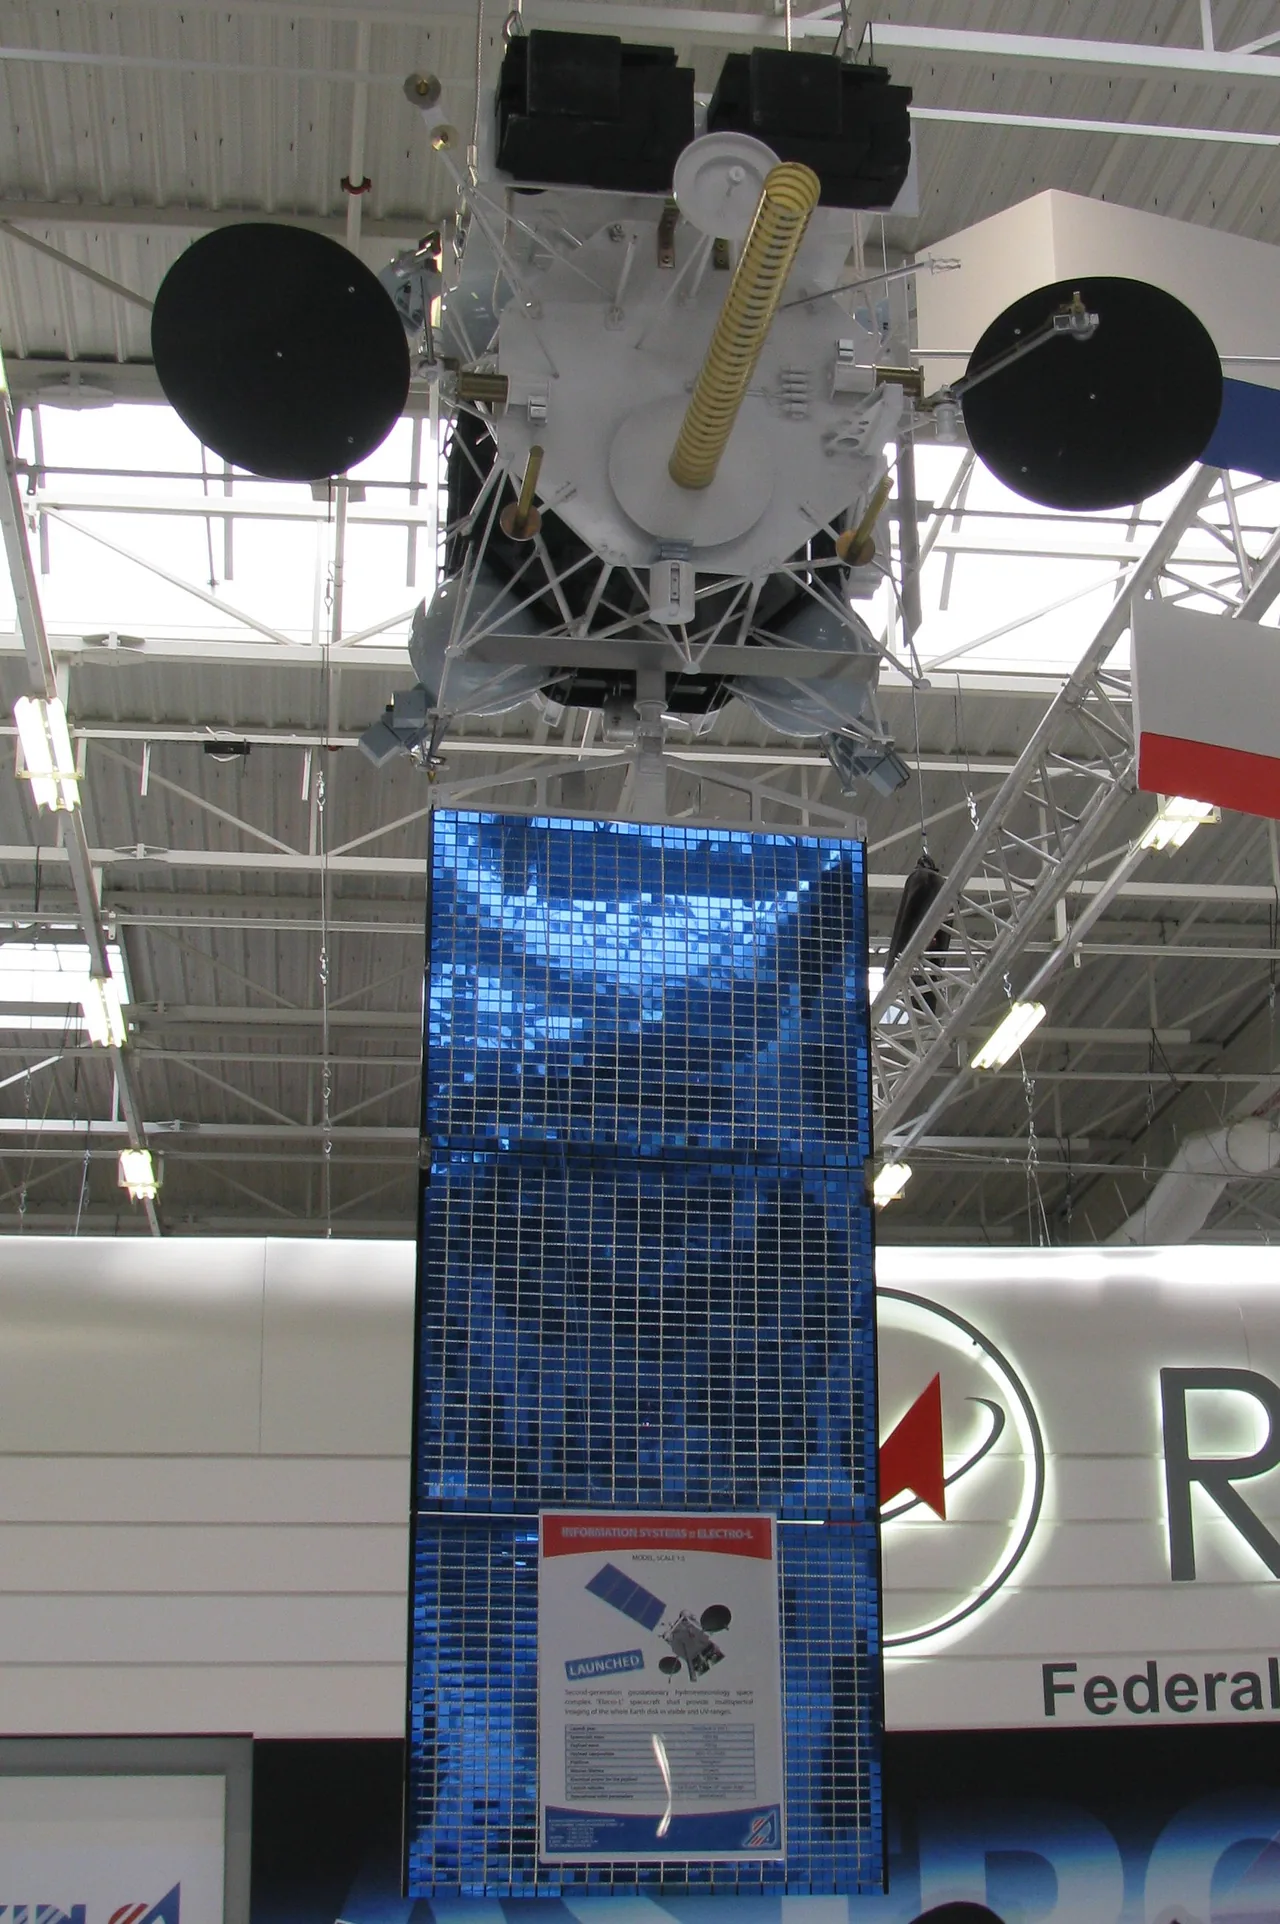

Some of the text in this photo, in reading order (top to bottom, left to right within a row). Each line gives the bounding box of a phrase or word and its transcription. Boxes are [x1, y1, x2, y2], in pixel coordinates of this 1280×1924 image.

[561, 1526, 754, 1540] INFORMATION SYSTEMS ELECTRO-L
[569, 1655, 640, 1676] LAUNCHED
[1042, 1657, 1280, 1717] Federal
